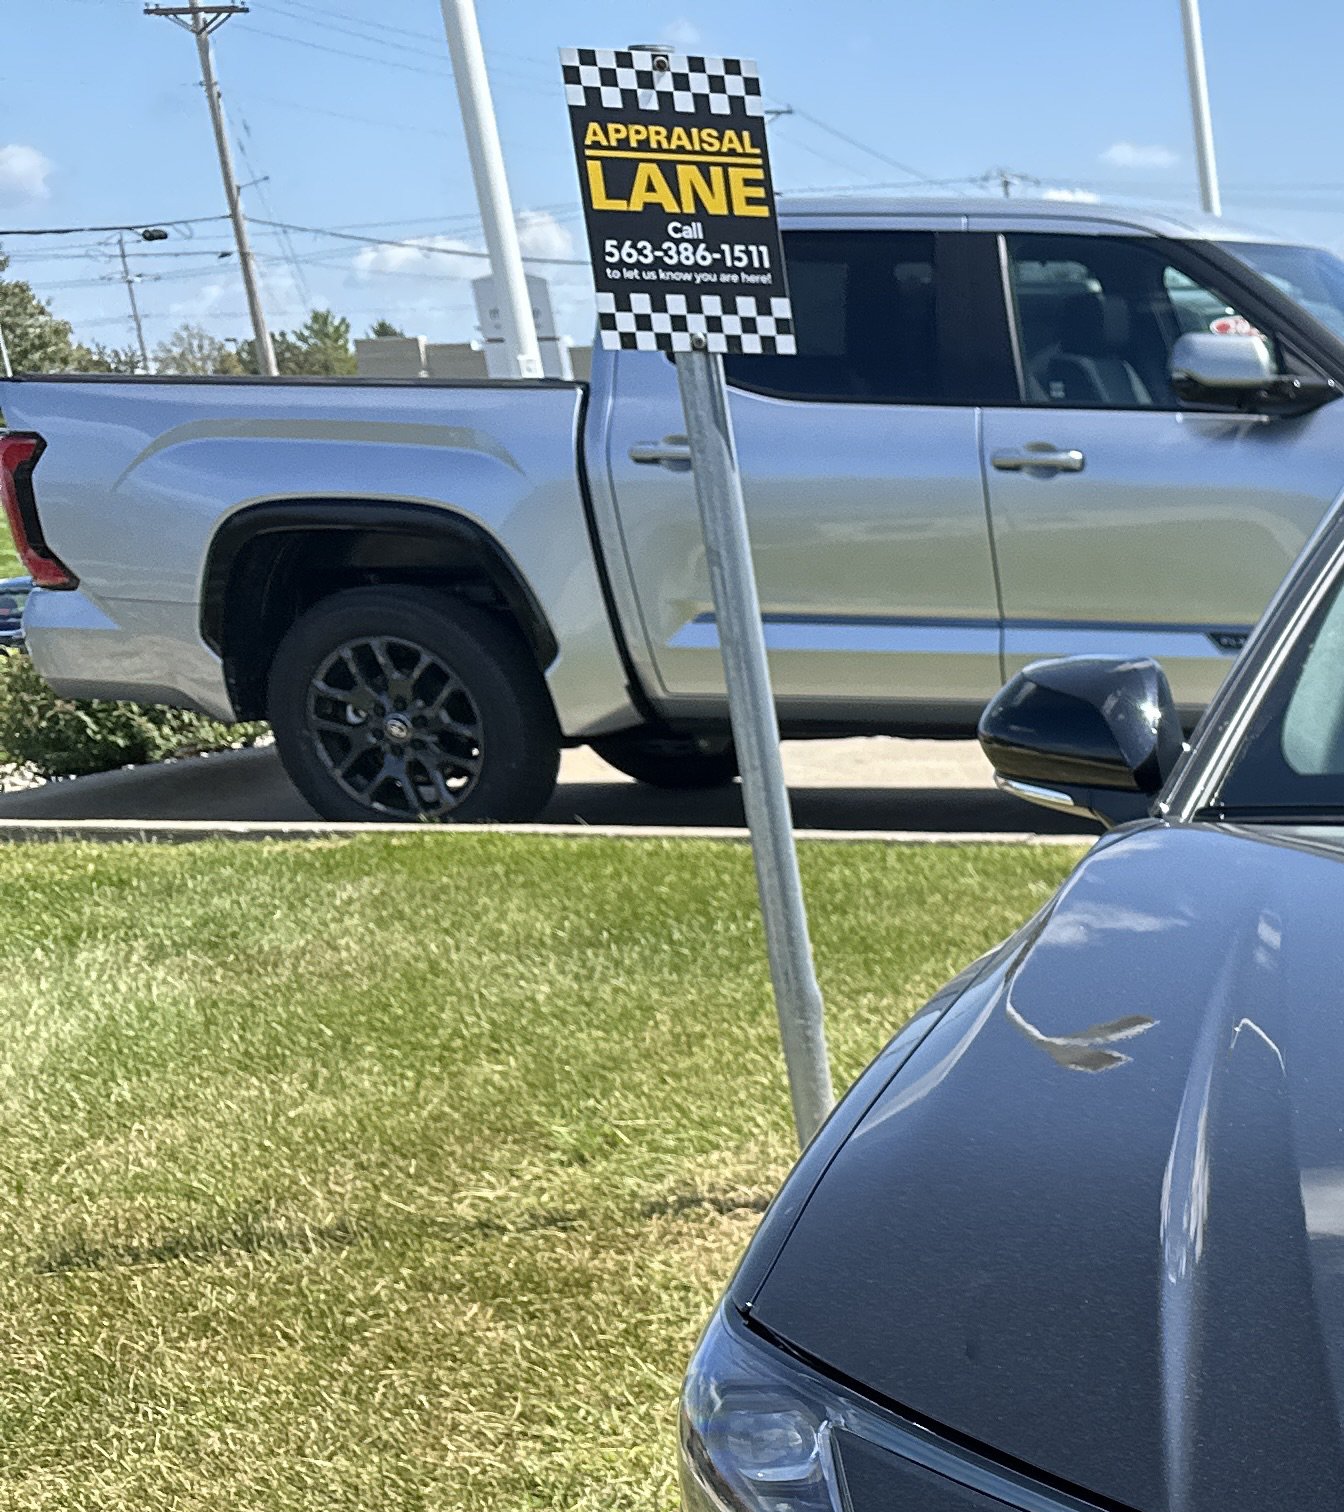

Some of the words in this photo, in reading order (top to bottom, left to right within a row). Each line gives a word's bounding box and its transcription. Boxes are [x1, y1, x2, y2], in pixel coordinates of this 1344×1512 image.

[584, 122, 761, 154] APPRAISAL
[586, 160, 770, 218] LANE
[667, 221, 704, 239] Call
[604, 239, 770, 268] 563-386-1511
[605, 267, 621, 280] to
[622, 267, 640, 280] let
[642, 270, 657, 281] us
[658, 269, 693, 282] know
[694, 272, 717, 284] you
[719, 272, 739, 283] are
[741, 271, 772, 284] here!
